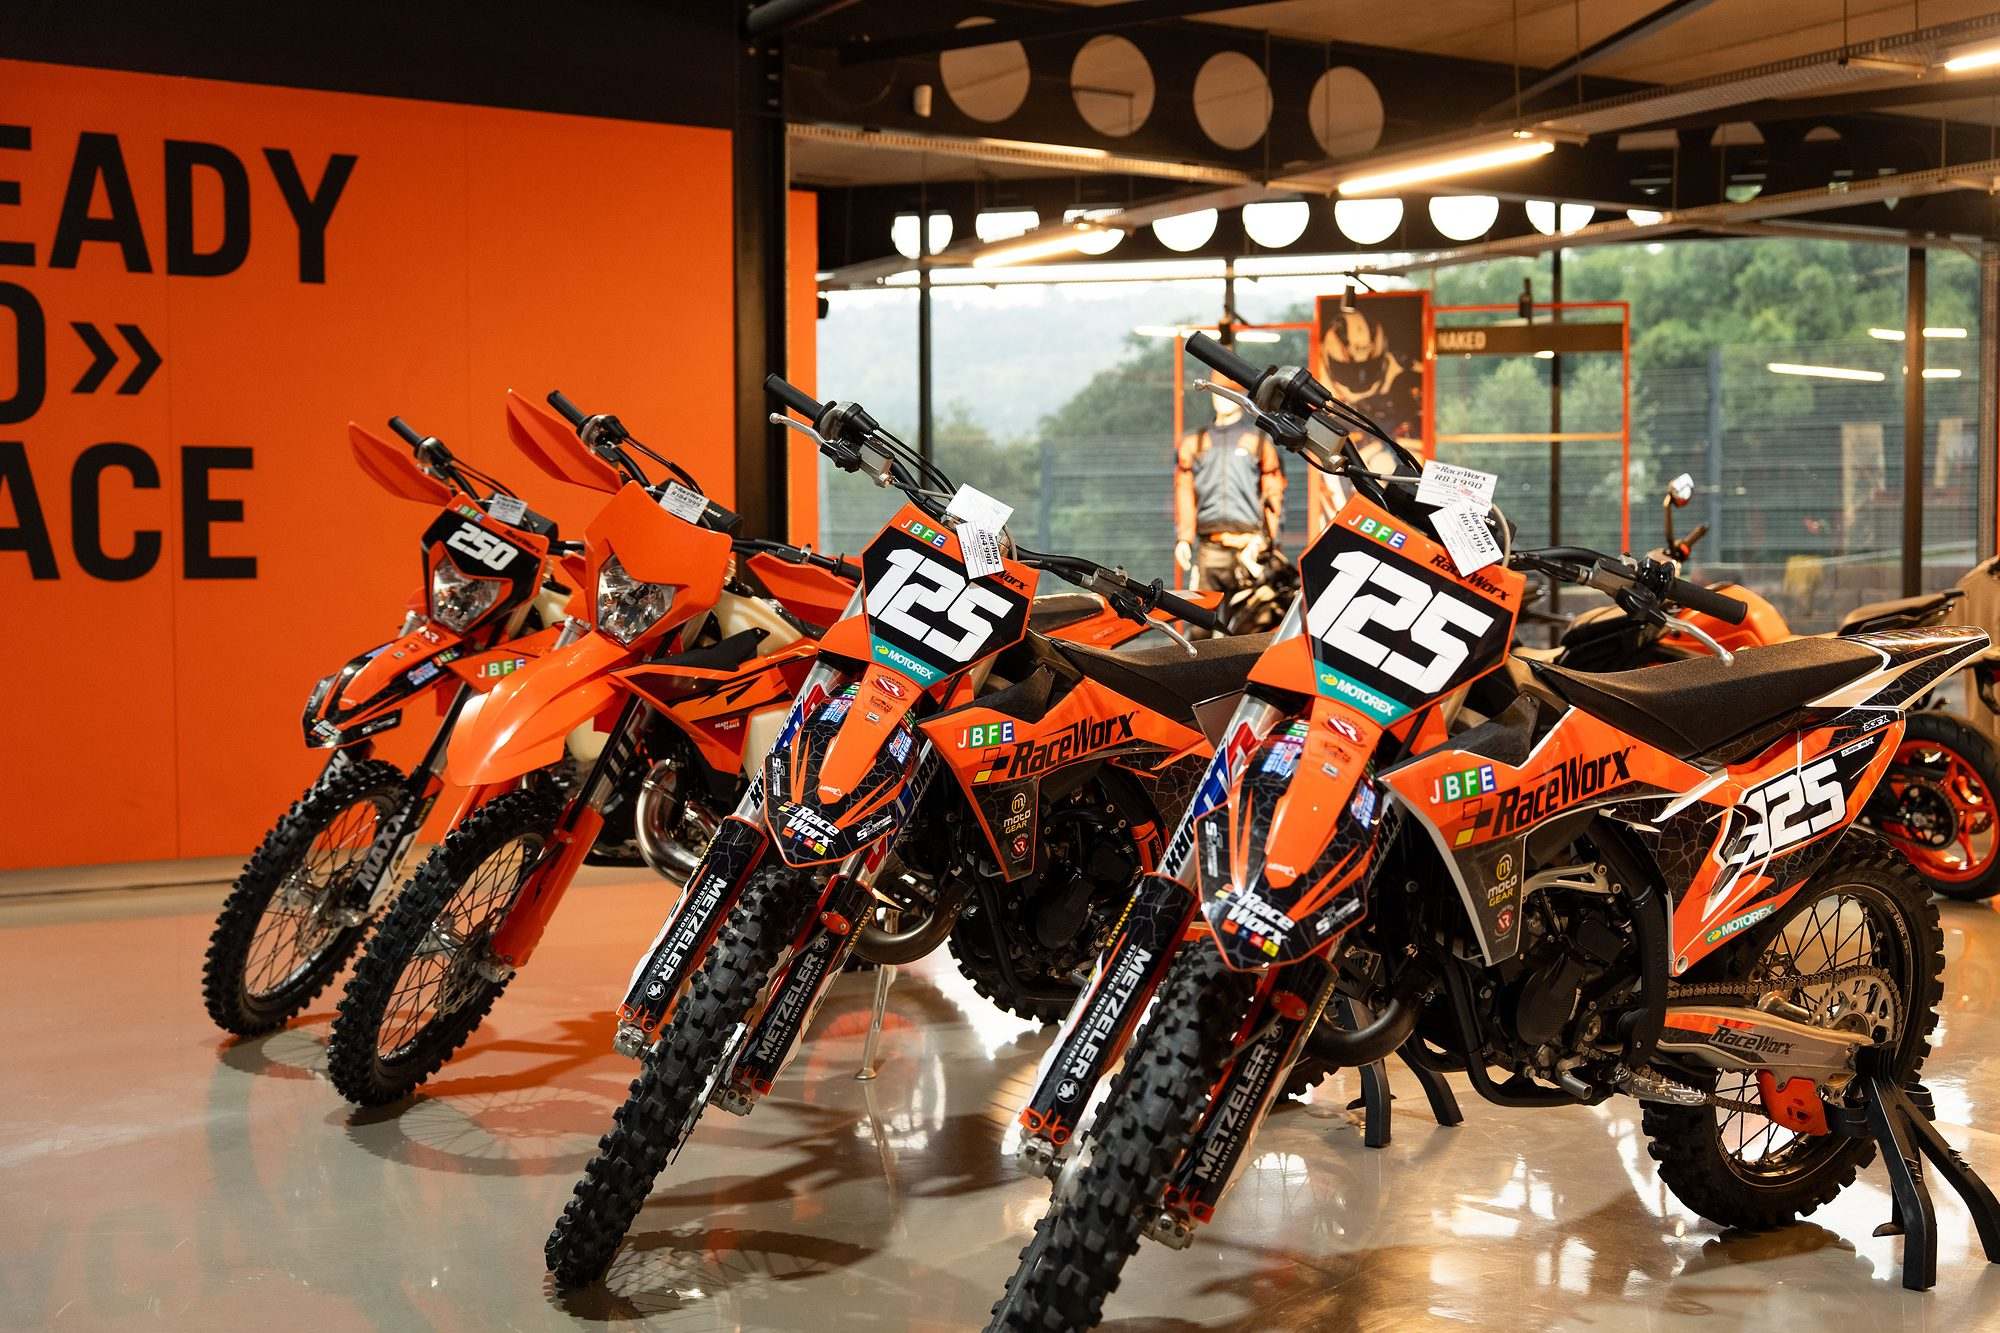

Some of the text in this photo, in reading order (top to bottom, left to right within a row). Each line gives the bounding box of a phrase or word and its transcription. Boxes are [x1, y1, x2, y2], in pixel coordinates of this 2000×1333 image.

[446, 522, 519, 571] 250
[901, 520, 946, 547] JBFE
[1348, 515, 1406, 549] JBFE
[1430, 554, 1510, 601] RaWorx
[866, 548, 1014, 662] 125
[1306, 551, 1494, 694] 125
[888, 649, 935, 680] MOTOREX
[1336, 678, 1398, 716] MOTOREX
[957, 722, 1014, 749] JBFE
[1007, 711, 1138, 779] RaceWorx
[1430, 765, 1495, 805] JBFE
[1492, 746, 1633, 838] RaceWorx
[785, 813, 836, 848] Worx
[794, 804, 840, 837] Race
[1003, 809, 1031, 828] moto
[1005, 820, 1028, 834] GEAR
[690, 874, 715, 912] SHARING
[1487, 874, 1518, 896] moto
[1488, 889, 1514, 907] GEAR
[658, 877, 728, 982] METZELER
[1224, 903, 1289, 946] Worx
[1237, 892, 1296, 931] Race
[1721, 904, 1776, 936] MOTOREX
[652, 912, 691, 974] INDEPENDENCE
[755, 953, 819, 1062] METZELER
[769, 958, 825, 1064] SHARING INDEPENDENCE
[1062, 944, 1137, 1072] SHARING INDEPENDENCE
[1069, 948, 1152, 1080] METZELER
[1708, 1024, 1793, 1055] RaceWorx
[1194, 1043, 1271, 1180] METZELER
[1210, 1051, 1280, 1184] SHARING INDEPENDENCE
